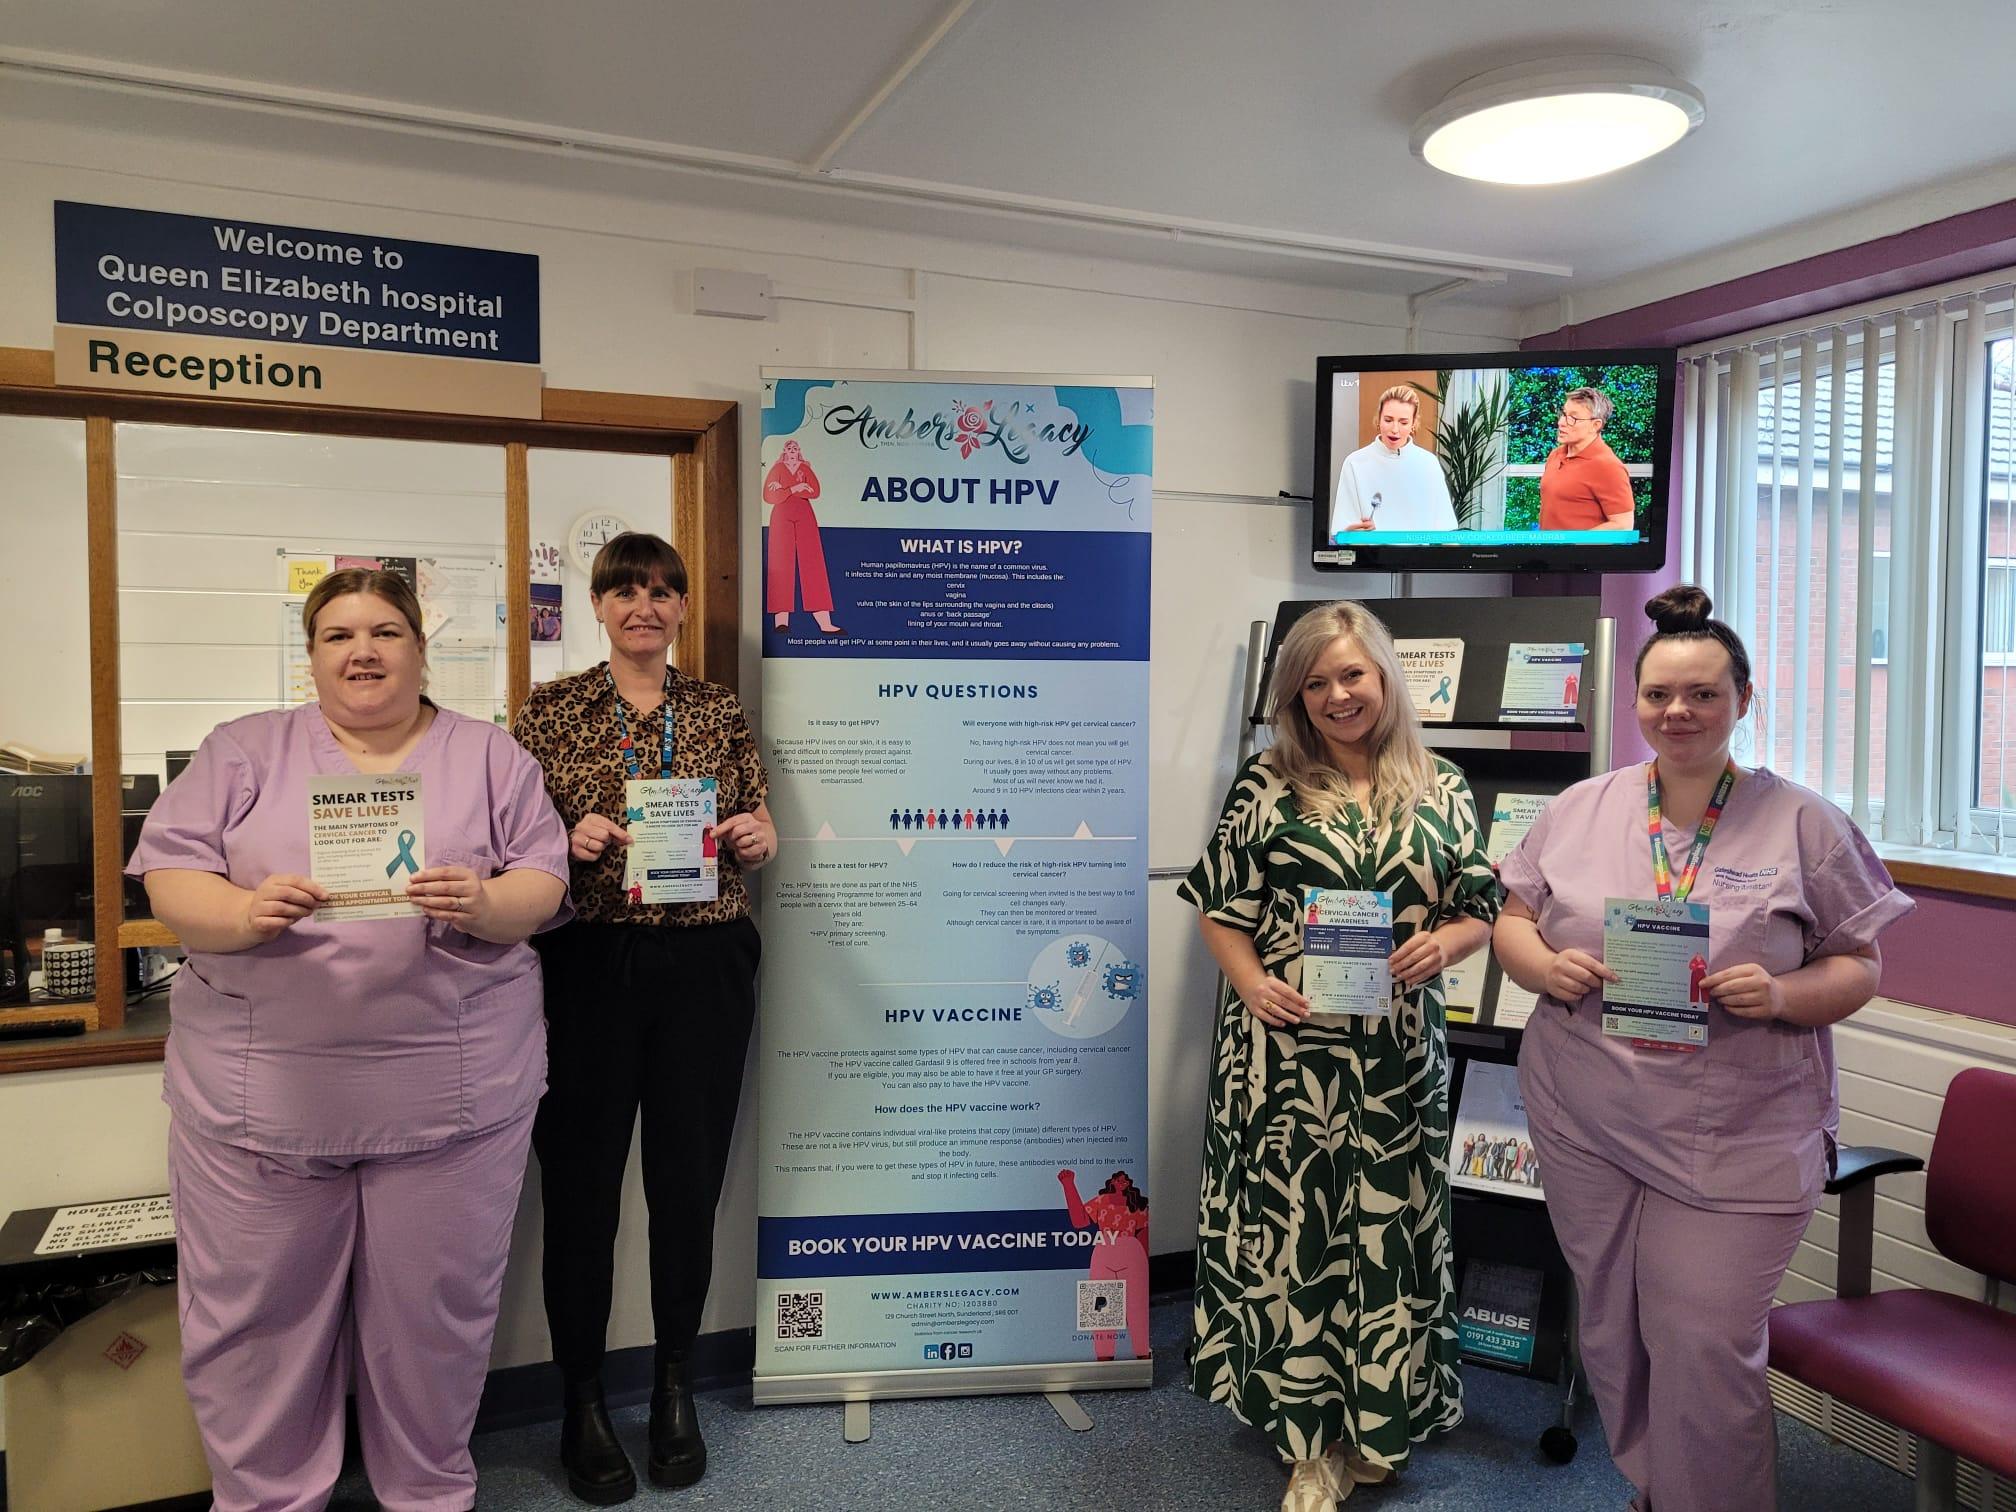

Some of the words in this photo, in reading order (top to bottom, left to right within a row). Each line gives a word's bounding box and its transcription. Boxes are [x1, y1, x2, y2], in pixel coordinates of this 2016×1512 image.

[213, 225, 363, 266] Welcome
[373, 246, 404, 270] to
[98, 254, 209, 289] Queen
[221, 266, 370, 305] Elizabeth
[382, 283, 502, 318] hospital
[106, 291, 309, 339] Colposcopy
[319, 311, 499, 351] Department
[88, 339, 322, 390] Reception
[861, 476, 980, 504] ABOUT
[989, 478, 1060, 505] HPV
[900, 539, 954, 553] WHAT
[958, 540, 973, 554] IS
[977, 540, 1022, 554] HPV?
[295, 567, 321, 575] Thank
[885, 562, 930, 570] papillomavirus
[931, 562, 951, 570] (HPV)
[1428, 651, 1456, 659] TESTS
[1400, 660, 1417, 668] AVE
[1419, 660, 1445, 668] LIVES
[878, 684, 918, 698] HPV
[925, 684, 1038, 699] QUESTIONS
[848, 720, 859, 728] get
[1024, 720, 1052, 729] high-risk
[1071, 721, 1082, 729] get
[1110, 720, 1136, 728] cancer?
[11, 785, 44, 797] AOC
[312, 792, 367, 805] SMEAR
[370, 790, 415, 802] TESTS
[645, 801, 674, 809] SMEAR
[676, 800, 700, 808] TESTS
[313, 807, 353, 819] SAVE
[357, 804, 399, 817] LIVES
[650, 810, 672, 818] SAVE
[673, 809, 695, 817] LIVES
[349, 822, 388, 830] SYMPTOMS
[314, 831, 348, 839] CERVICAL
[349, 829, 377, 837] CANCER
[1041, 861, 1071, 870] high-risk
[1088, 861, 1112, 870] turning
[1714, 866, 1742, 877] Gateshead
[1760, 868, 1777, 876] NHS
[1713, 879, 1740, 891] Nursing
[359, 890, 390, 898] CERVICAL
[345, 896, 392, 905] APPOINTMENT
[1319, 909, 1352, 917] CERVICAL
[1651, 924, 1681, 932] VACCINE
[885, 1009, 925, 1023] HPV
[932, 1007, 1022, 1022] VACCINE
[1655, 1010, 1680, 1018] VACCINE
[874, 1105, 897, 1114] How
[899, 1104, 924, 1113] does
[927, 1103, 943, 1113] the
[945, 1103, 967, 1112] HPV
[969, 1103, 1008, 1112] vaccine
[1010, 1102, 1041, 1111] work?
[67, 1200, 159, 1216] HOUSEHOLD
[97, 1208, 142, 1218] BLACK
[81, 1217, 145, 1229] CLINICAL
[78, 1224, 134, 1235] SHARPS
[72, 1236, 129, 1248] BROKEN
[75, 1232, 121, 1242] GLASS
[788, 1237, 847, 1256] BOOK
[851, 1236, 907, 1253] YOUR
[912, 1234, 953, 1252] HPV
[956, 1231, 1047, 1250] VACCINE
[1050, 1230, 1120, 1247] TODAY
[871, 1287, 1020, 1300] WWW.AMBERSLEGACY.COM
[906, 1302, 942, 1310] CHARITY
[963, 1300, 998, 1308] 1203880
[911, 1319, 995, 1328] admin@amberslegacy.com
[1463, 1306, 1531, 1331] ABUSE
[1072, 1334, 1103, 1342] DONATE
[1466, 1330, 1484, 1341] 0191
[1485, 1335, 1500, 1345] 433
[1501, 1337, 1520, 1348] 3333
[774, 1345, 794, 1353] SCAN
[812, 1343, 846, 1351] FURTHER
[847, 1341, 897, 1350] INFORMATION
